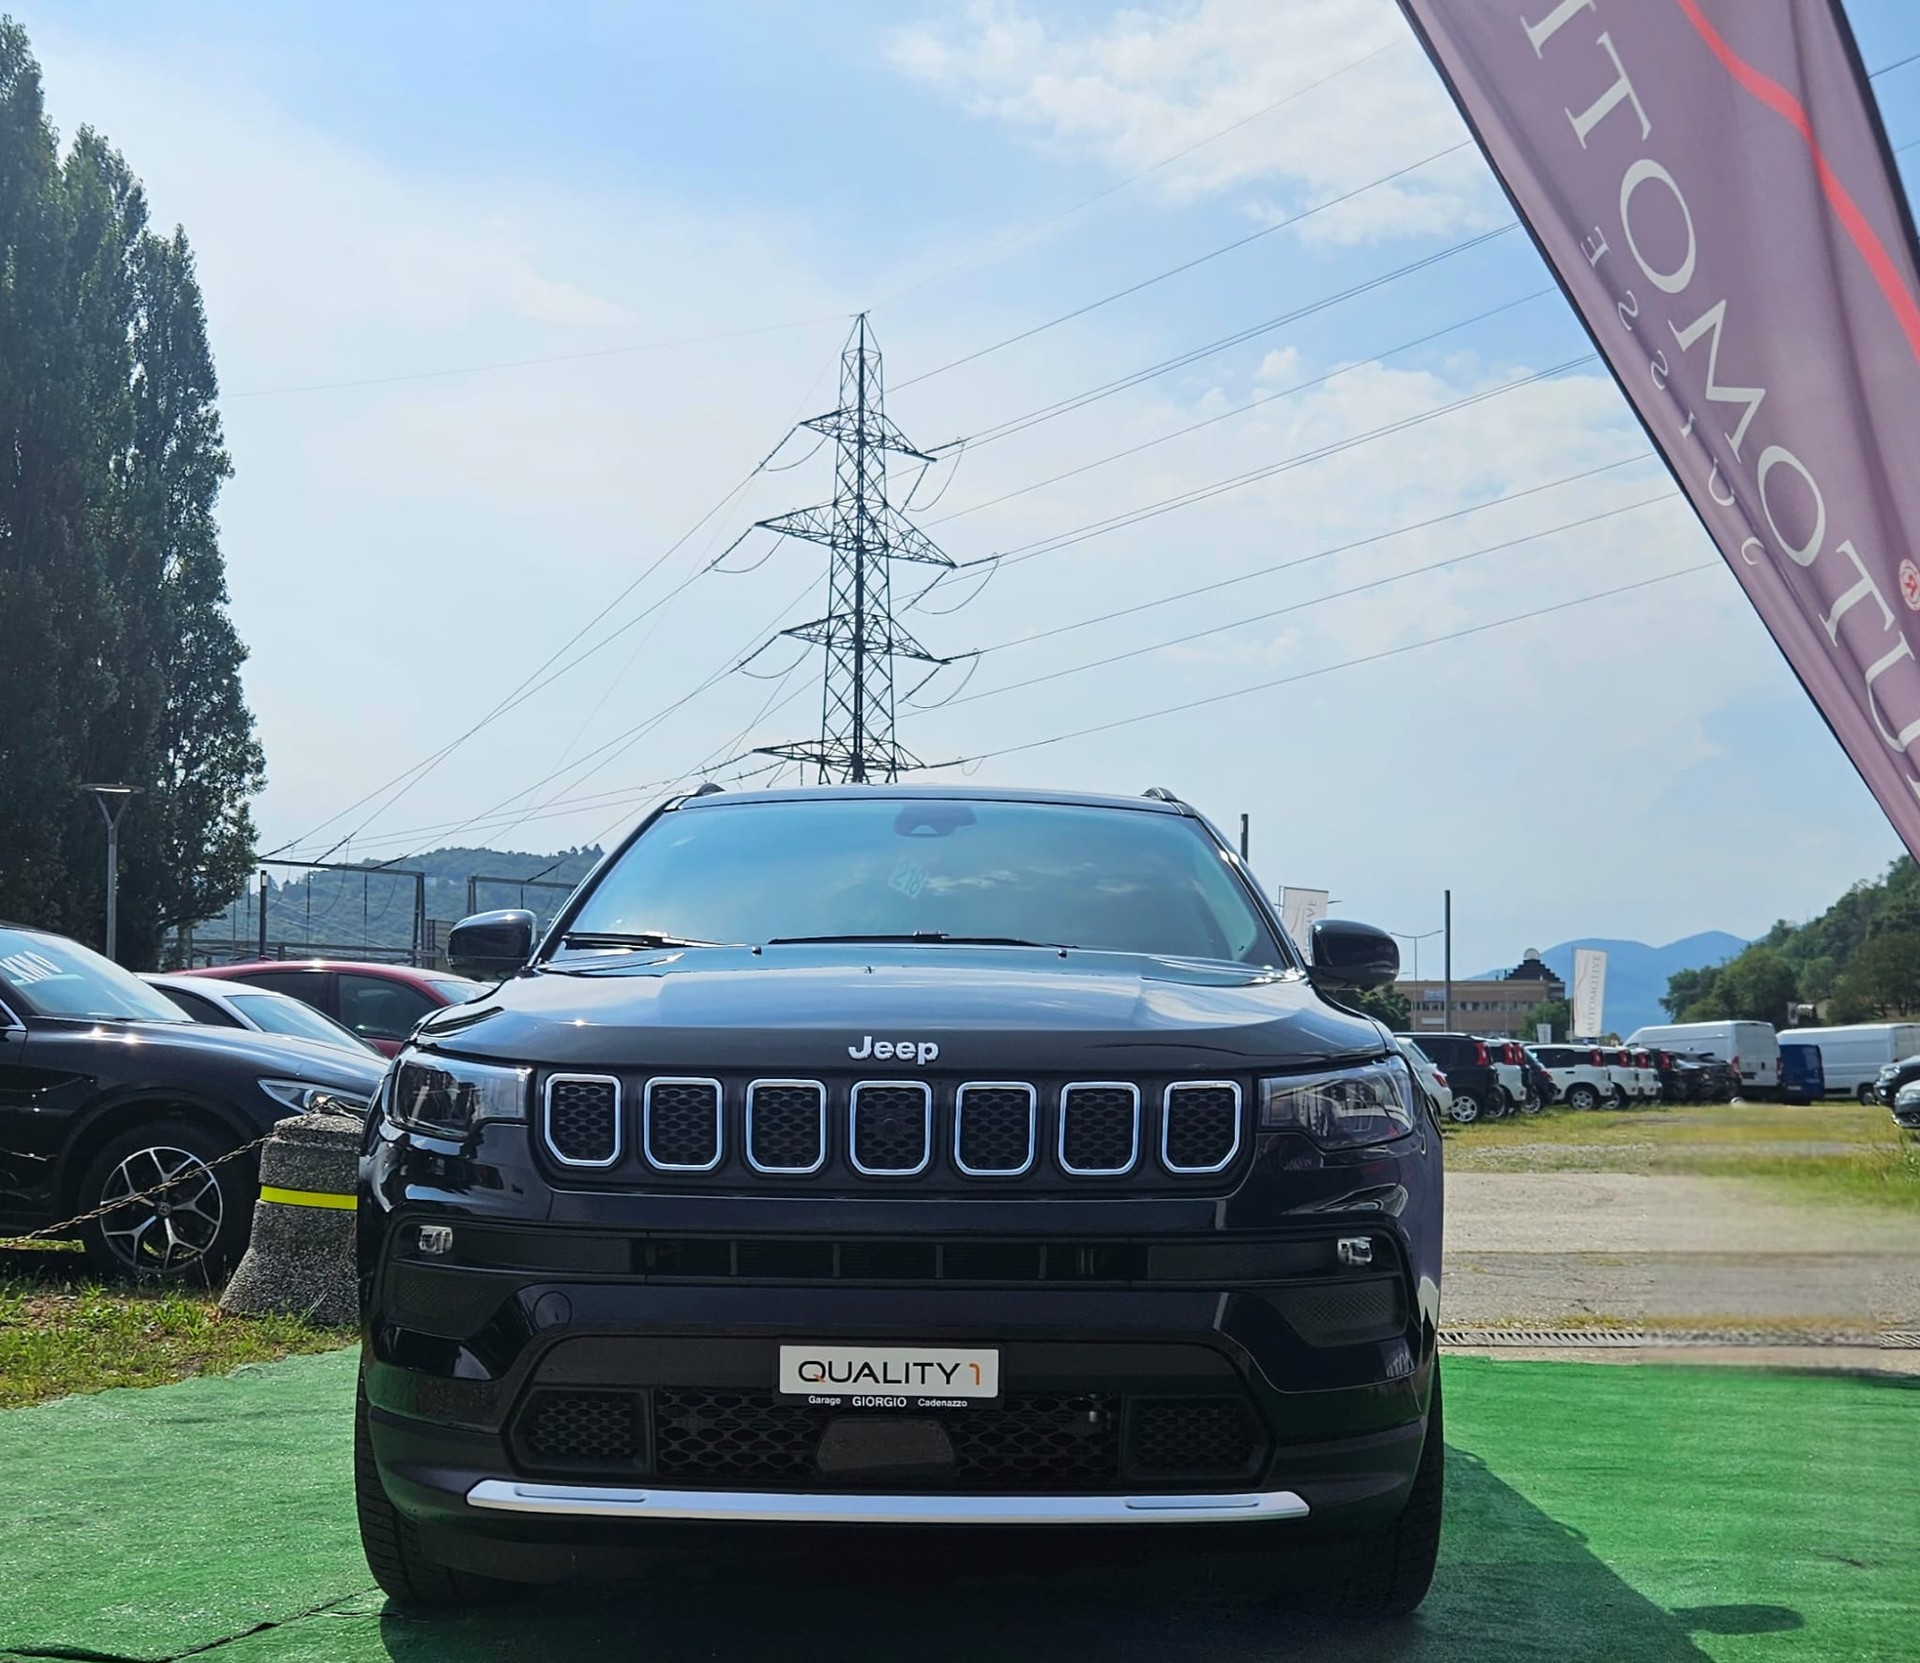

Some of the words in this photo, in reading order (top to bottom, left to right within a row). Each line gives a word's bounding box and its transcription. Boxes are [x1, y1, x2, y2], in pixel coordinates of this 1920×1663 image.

[848, 1035, 939, 1065] Jeep
[798, 1360, 961, 1385] QUALITY
[969, 1363, 980, 1386] 1
[808, 1395, 841, 1407] Garage
[852, 1396, 907, 1408] GIORGIO
[918, 1398, 968, 1408] Cadenazzo
